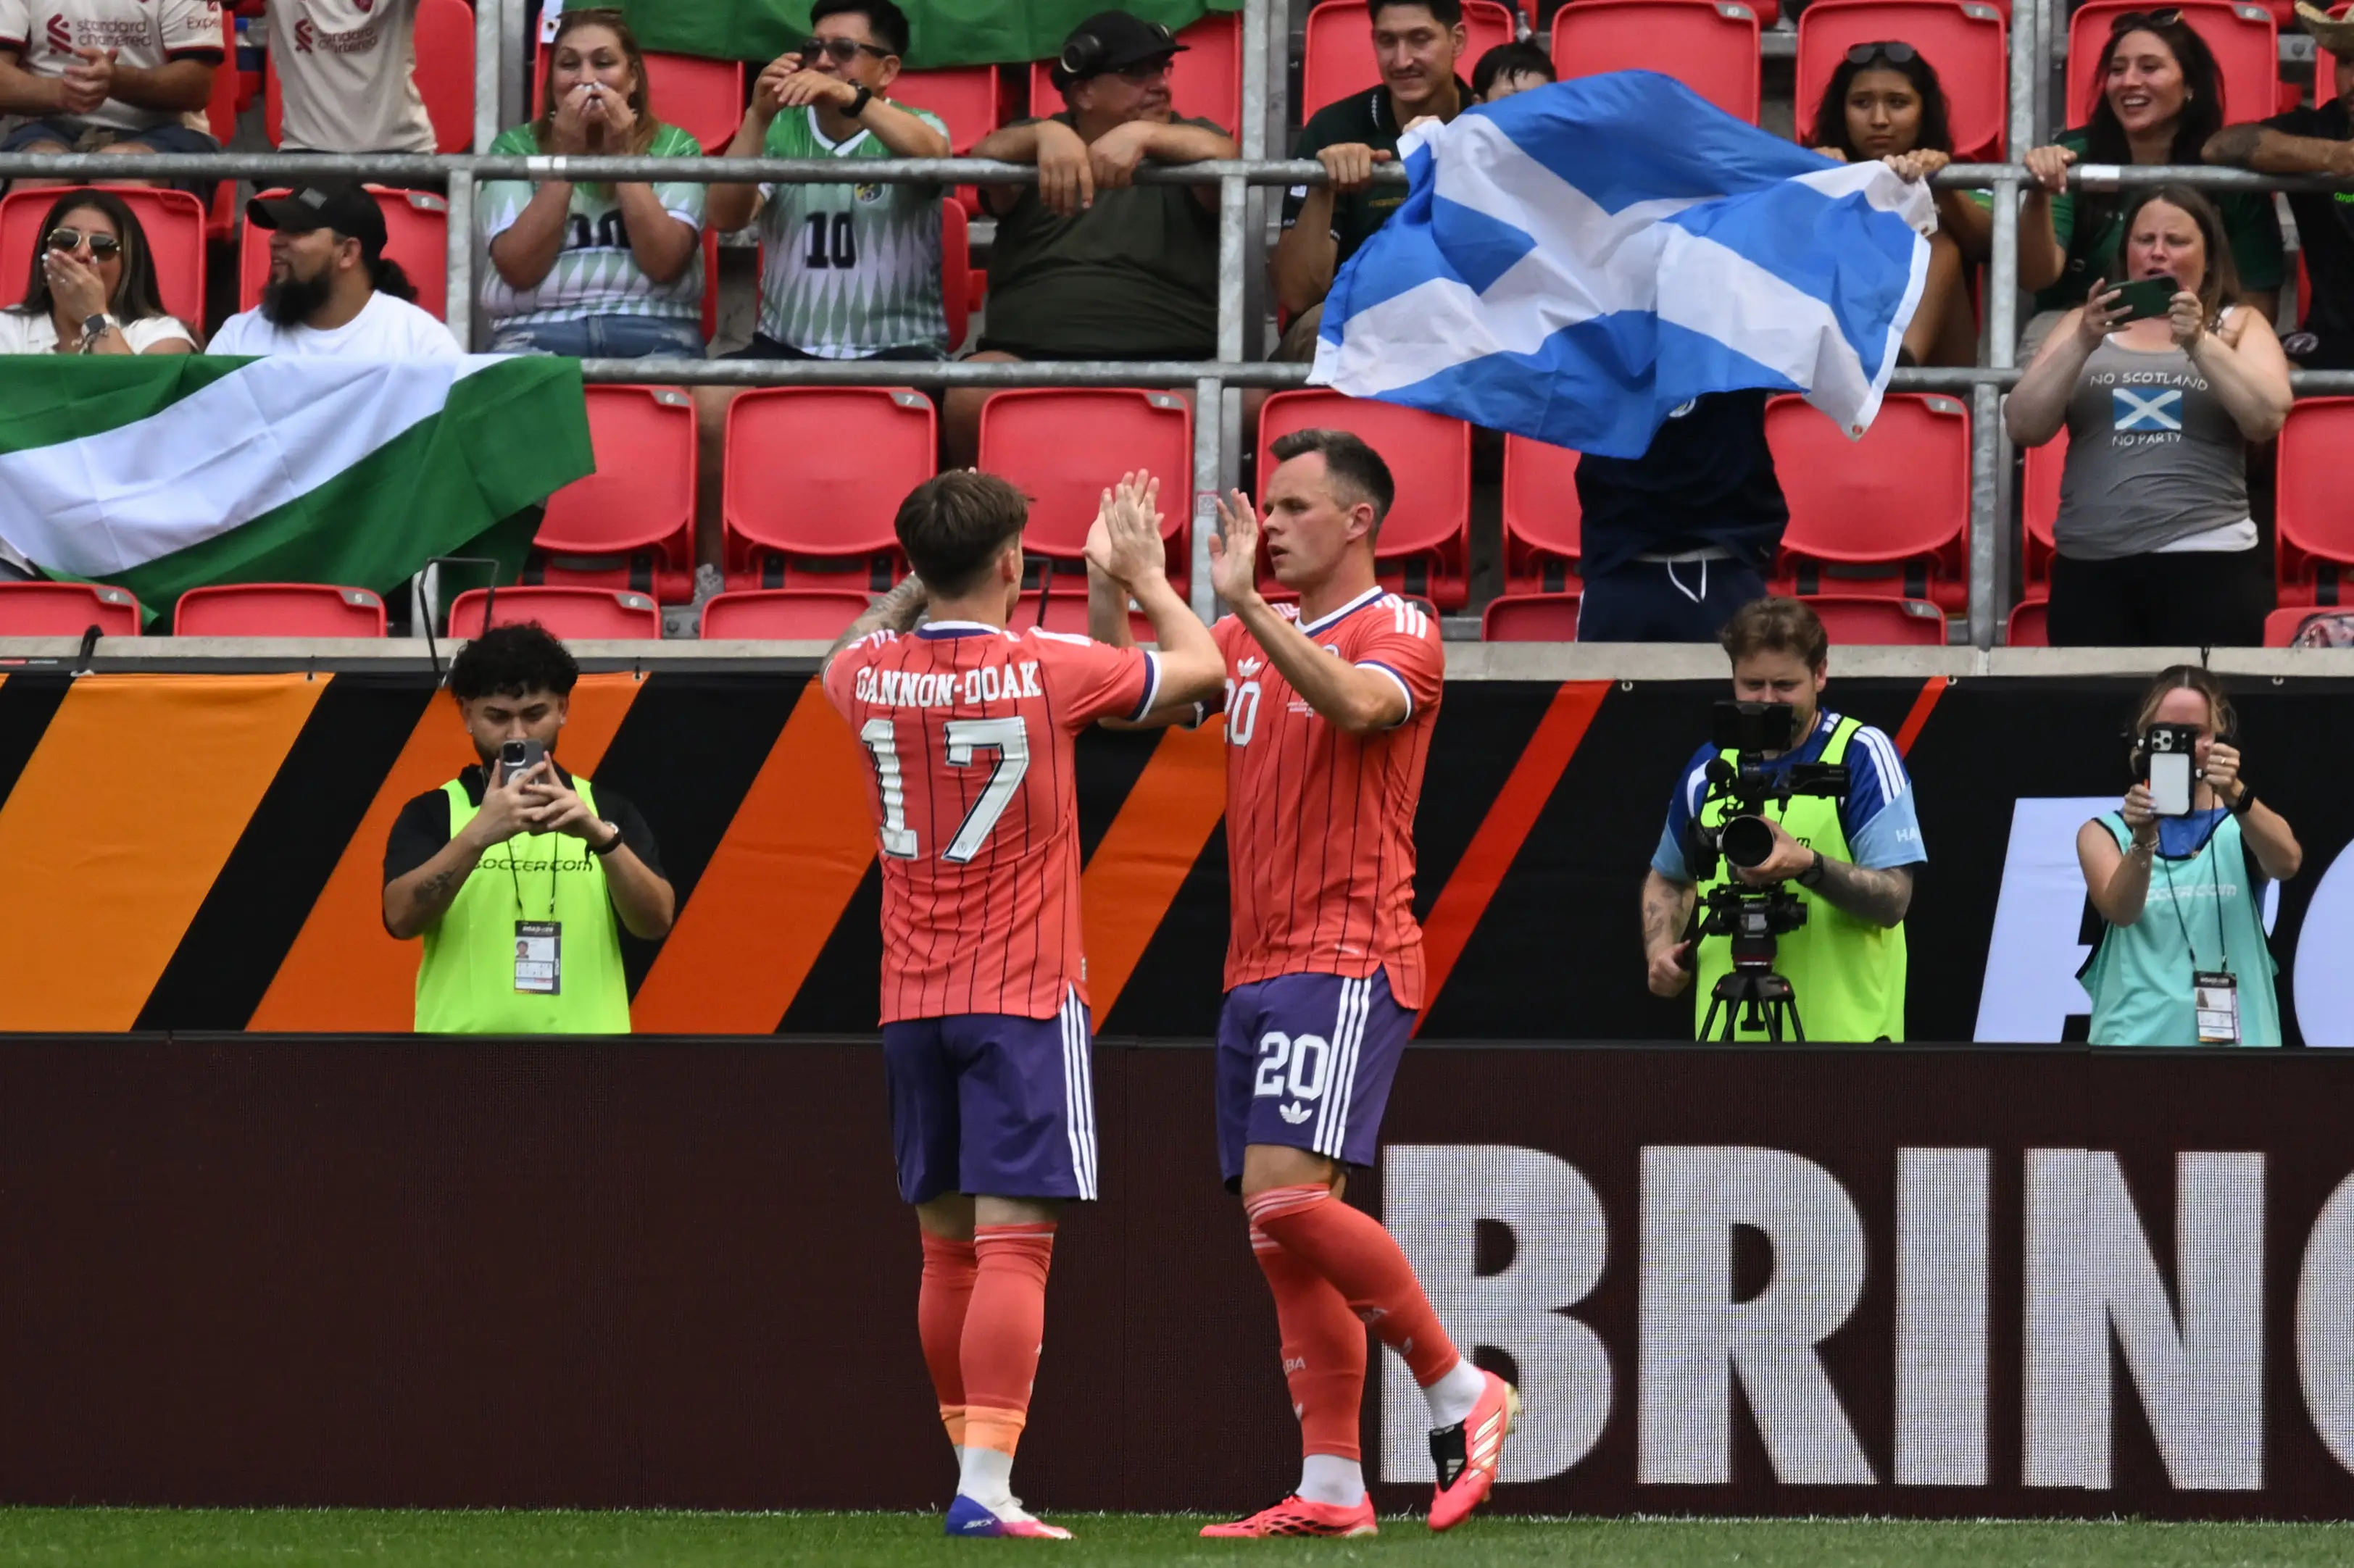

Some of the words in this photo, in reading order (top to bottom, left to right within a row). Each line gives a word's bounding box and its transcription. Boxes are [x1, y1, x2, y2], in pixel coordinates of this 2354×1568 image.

[77, 18, 147, 33] standard
[78, 34, 152, 47] chartered
[805, 212, 857, 269] 10
[2090, 372, 2116, 386] NO
[2122, 372, 2208, 391] SCOTLAND
[666, 393, 675, 403] 6
[905, 395, 915, 405] 7
[2112, 435, 2135, 446] NO
[2138, 432, 2182, 446] PARTY
[109, 592, 117, 601] 4
[355, 593, 362, 604] 5
[855, 661, 1042, 708] GANNON-DOAK
[860, 716, 1030, 864] 17
[1253, 1031, 1330, 1101] 20
[1379, 1143, 2354, 1491] BRIN
